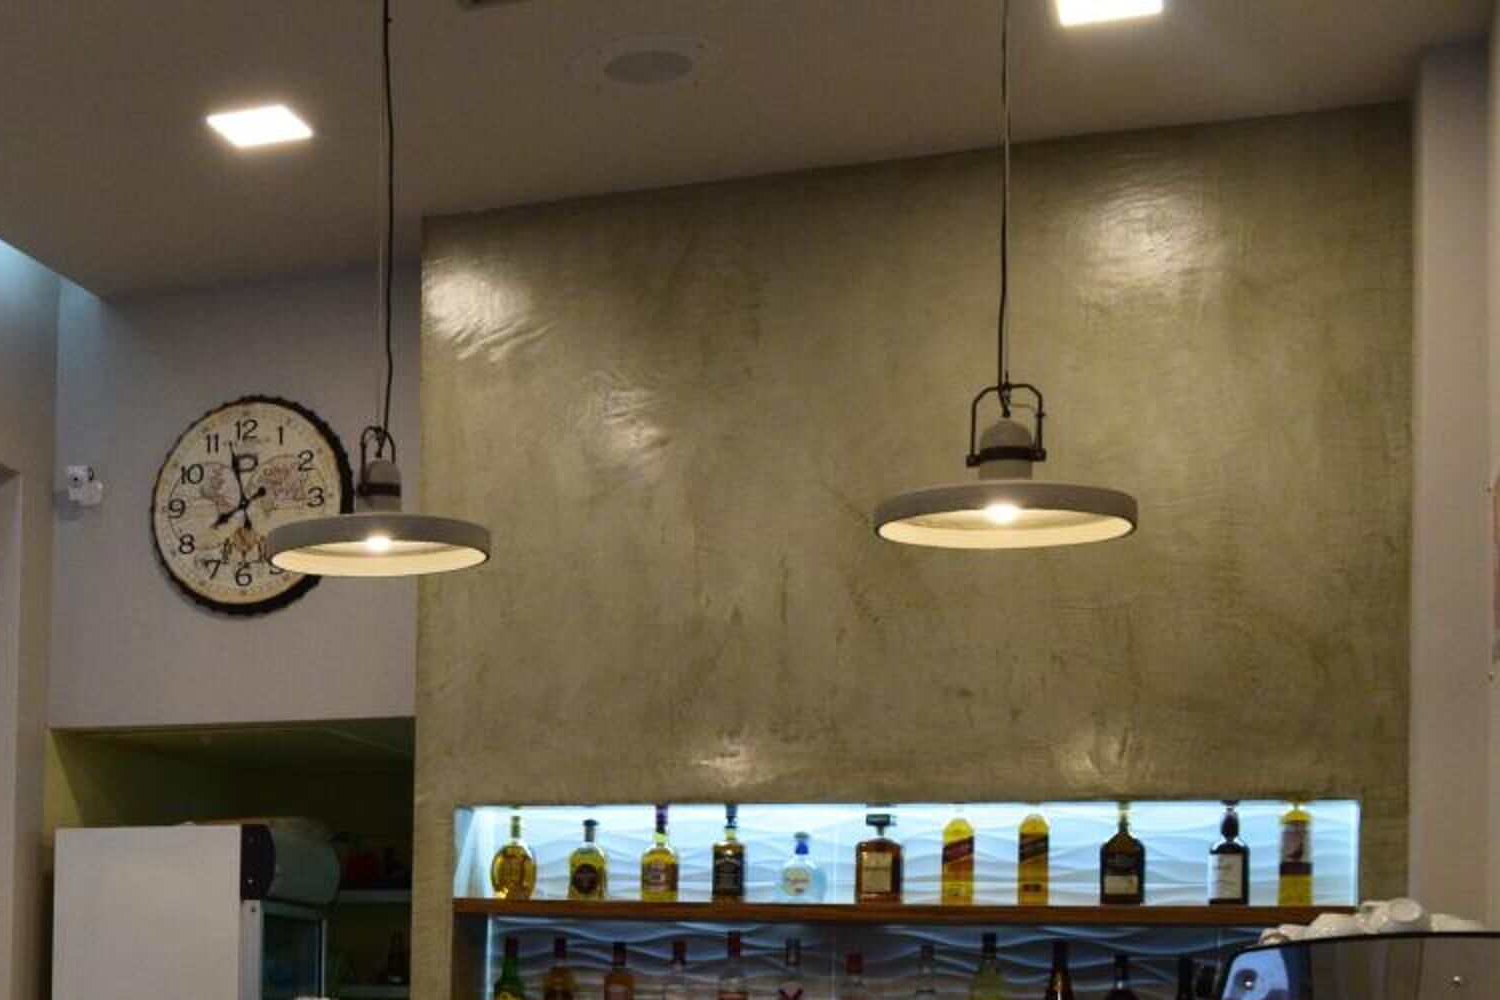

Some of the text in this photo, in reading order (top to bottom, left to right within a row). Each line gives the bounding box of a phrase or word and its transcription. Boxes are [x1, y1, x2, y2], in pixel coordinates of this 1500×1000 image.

[234, 419, 258, 441] 12
[275, 425, 284, 445] 1
[205, 433, 220, 454] 11
[298, 450, 315, 471] 2
[180, 463, 204, 484] 10
[307, 487, 324, 508] 3
[167, 499, 186, 519] 9
[178, 533, 195, 555] 8
[204, 559, 221, 581] 7
[235, 564, 252, 587] 6
